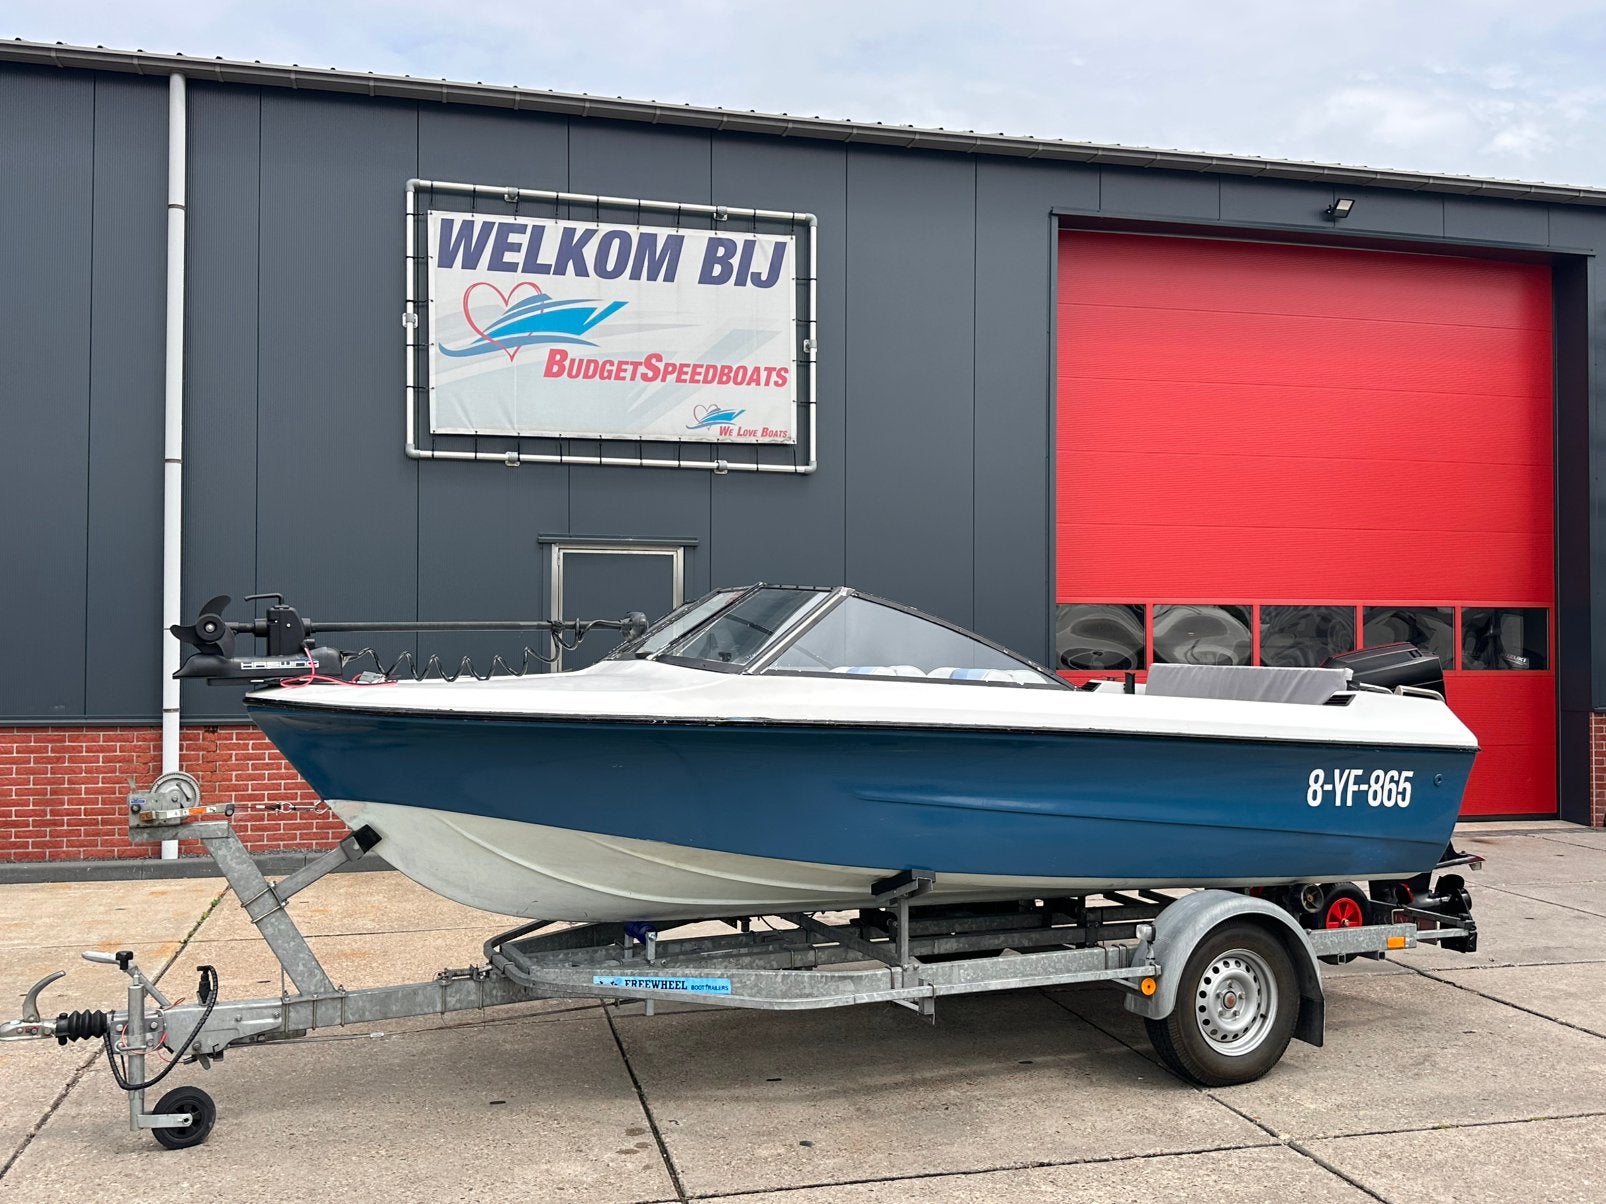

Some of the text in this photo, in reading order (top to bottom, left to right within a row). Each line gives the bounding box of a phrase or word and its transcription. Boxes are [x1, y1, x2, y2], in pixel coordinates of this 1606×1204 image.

[437, 218, 787, 289] WELKOM BIJ
[543, 348, 789, 388] BUDGETSPEEDBOATS
[719, 426, 788, 438] WE LOVE BOATS
[1307, 768, 1414, 808] 8-YF-865
[624, 979, 688, 990] FREEWHEEL
